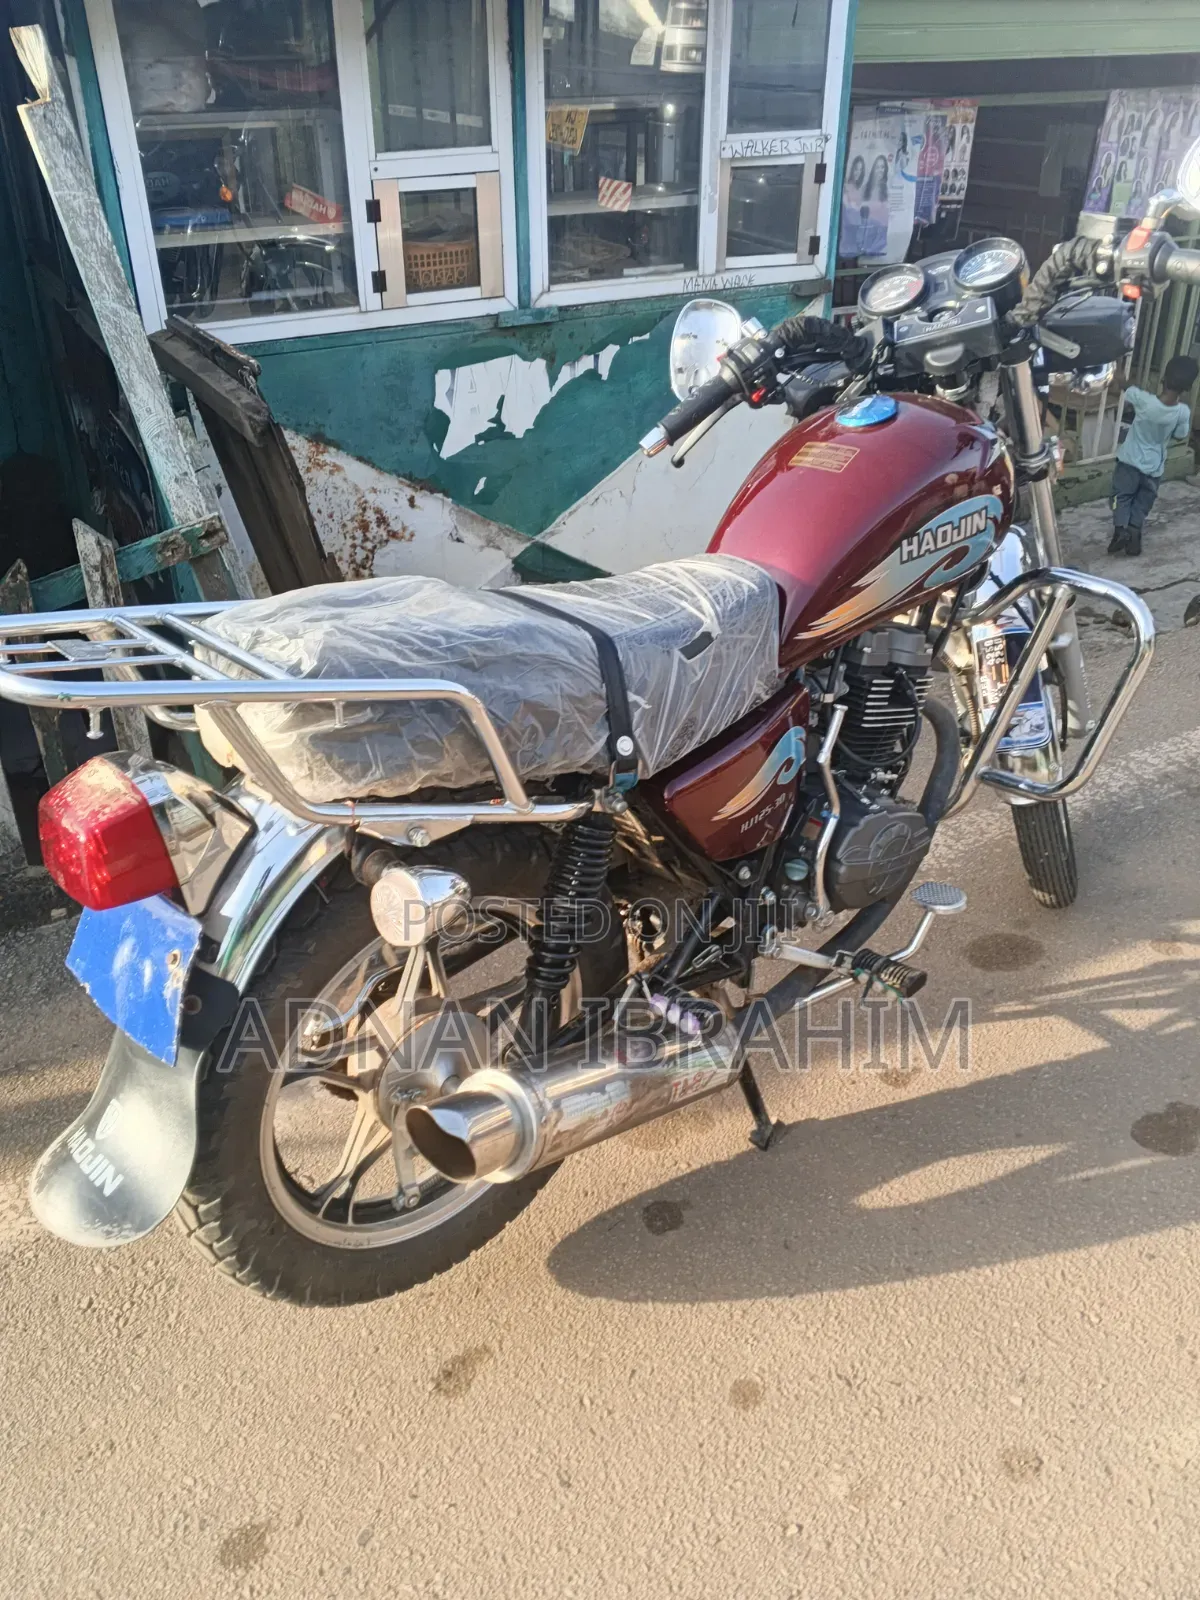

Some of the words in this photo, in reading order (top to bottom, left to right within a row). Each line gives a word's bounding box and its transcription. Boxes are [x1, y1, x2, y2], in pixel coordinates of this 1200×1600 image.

[730, 138, 792, 158] WALKER
[682, 276, 718, 293] MAMA
[899, 506, 988, 565] HAOJIN
[66, 1124, 125, 1197] HAOJIN
